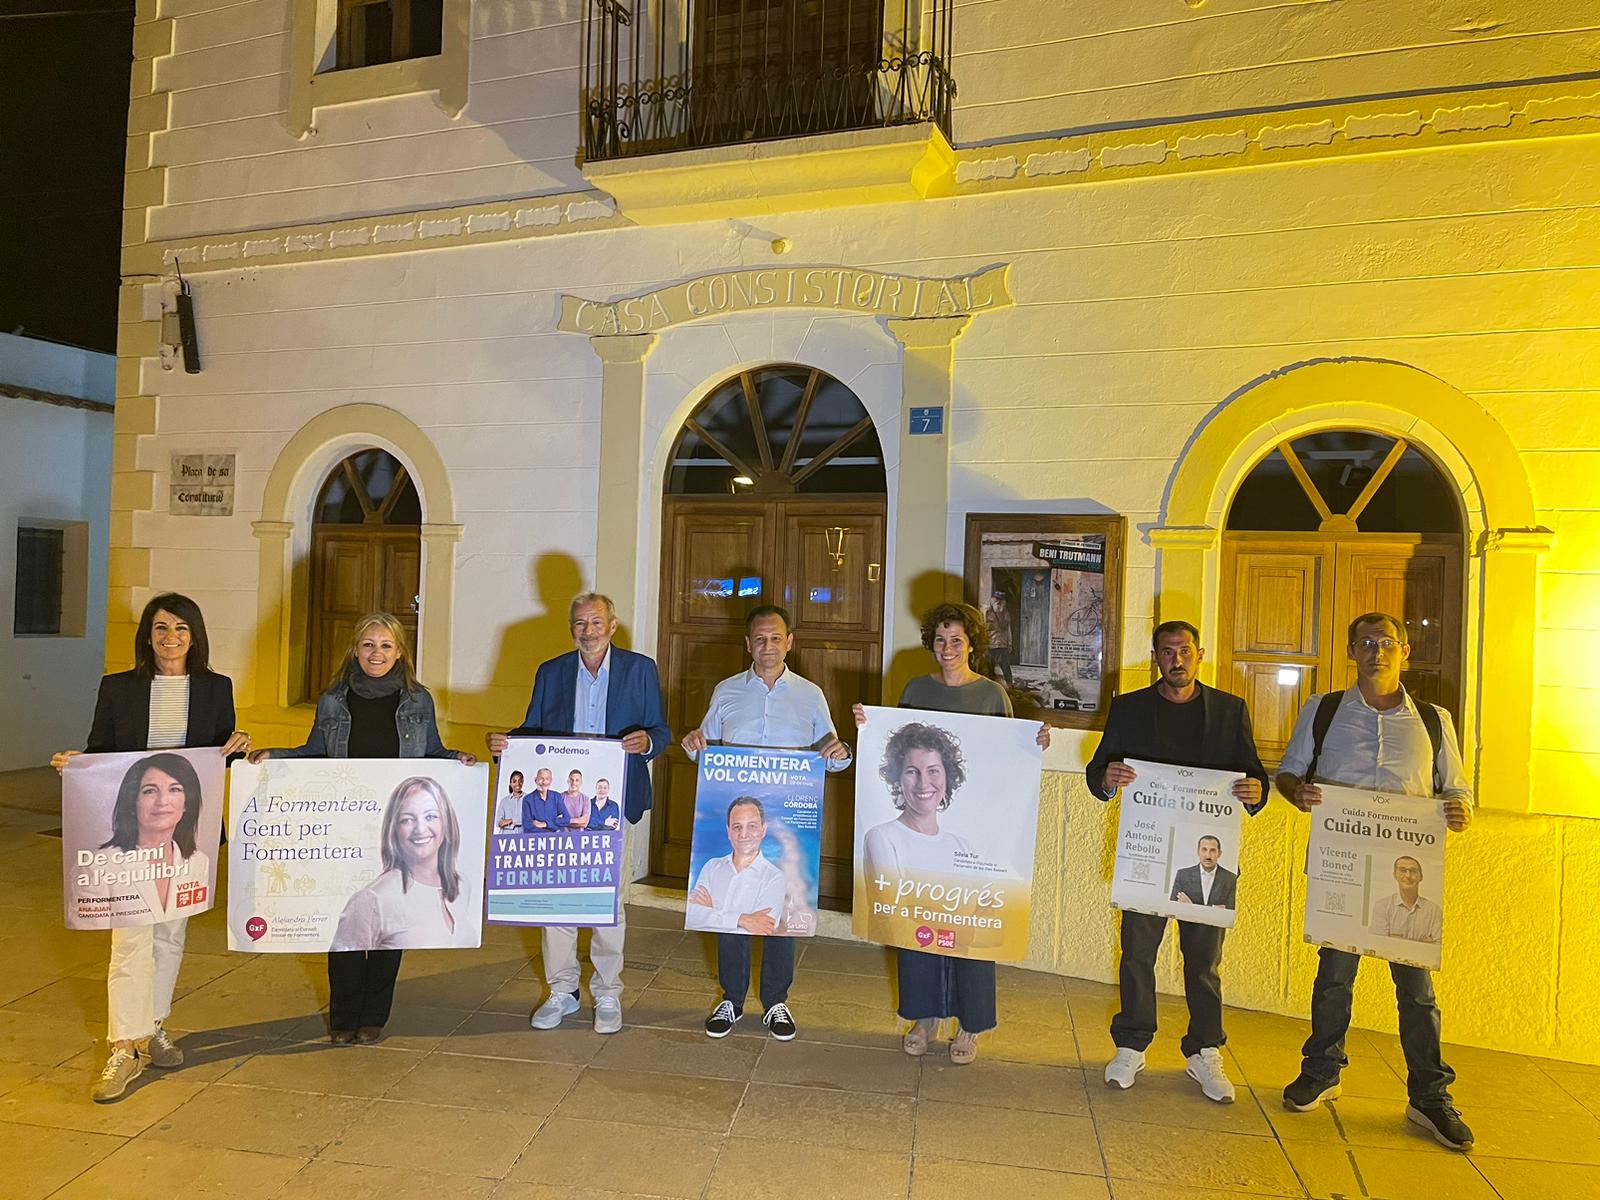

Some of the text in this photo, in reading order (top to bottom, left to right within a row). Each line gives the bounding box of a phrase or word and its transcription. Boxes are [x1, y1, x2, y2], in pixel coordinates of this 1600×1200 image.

[575, 270, 994, 334] CASA CONSISTORIAL
[922, 418, 930, 432] 7
[207, 466, 217, 476] de
[219, 468, 229, 476] sa
[1039, 548, 1102, 563] BENI TRUTMANN
[548, 745, 590, 755] Podemos
[704, 753, 811, 772] FORMENTERA
[704, 768, 735, 782] VOL
[737, 770, 787, 785] CANVI
[1177, 769, 1194, 777] VOX
[1172, 784, 1218, 797] Formentera
[245, 796, 383, 814] A Formentera,
[1133, 791, 1176, 809] Cuida
[1199, 800, 1233, 818] tuyo
[1372, 795, 1390, 804] VOX
[1342, 807, 1418, 825] Cuida Formentera
[243, 818, 332, 841] Gent per
[1134, 819, 1156, 830] José
[1125, 830, 1163, 843] Antonio
[1324, 818, 1436, 847] Cuida lo tuyo
[498, 835, 611, 852] VALENTIA PER
[1125, 842, 1161, 855] Rebollo
[77, 843, 166, 866] De camí
[242, 843, 363, 861] Formentera
[1320, 846, 1358, 860] Vicente
[495, 852, 615, 868] TRANSFORMAR
[1322, 859, 1353, 872] Boned
[77, 874, 90, 887] a
[496, 867, 613, 886] FORMENTERA
[176, 881, 200, 891] VOTA
[92, 894, 140, 903] FORMENTERA
[895, 878, 1006, 912] progrés
[116, 908, 152, 917] PRESIDENTA
[873, 902, 1002, 929] per a Formentera
[249, 924, 265, 932] GxF
